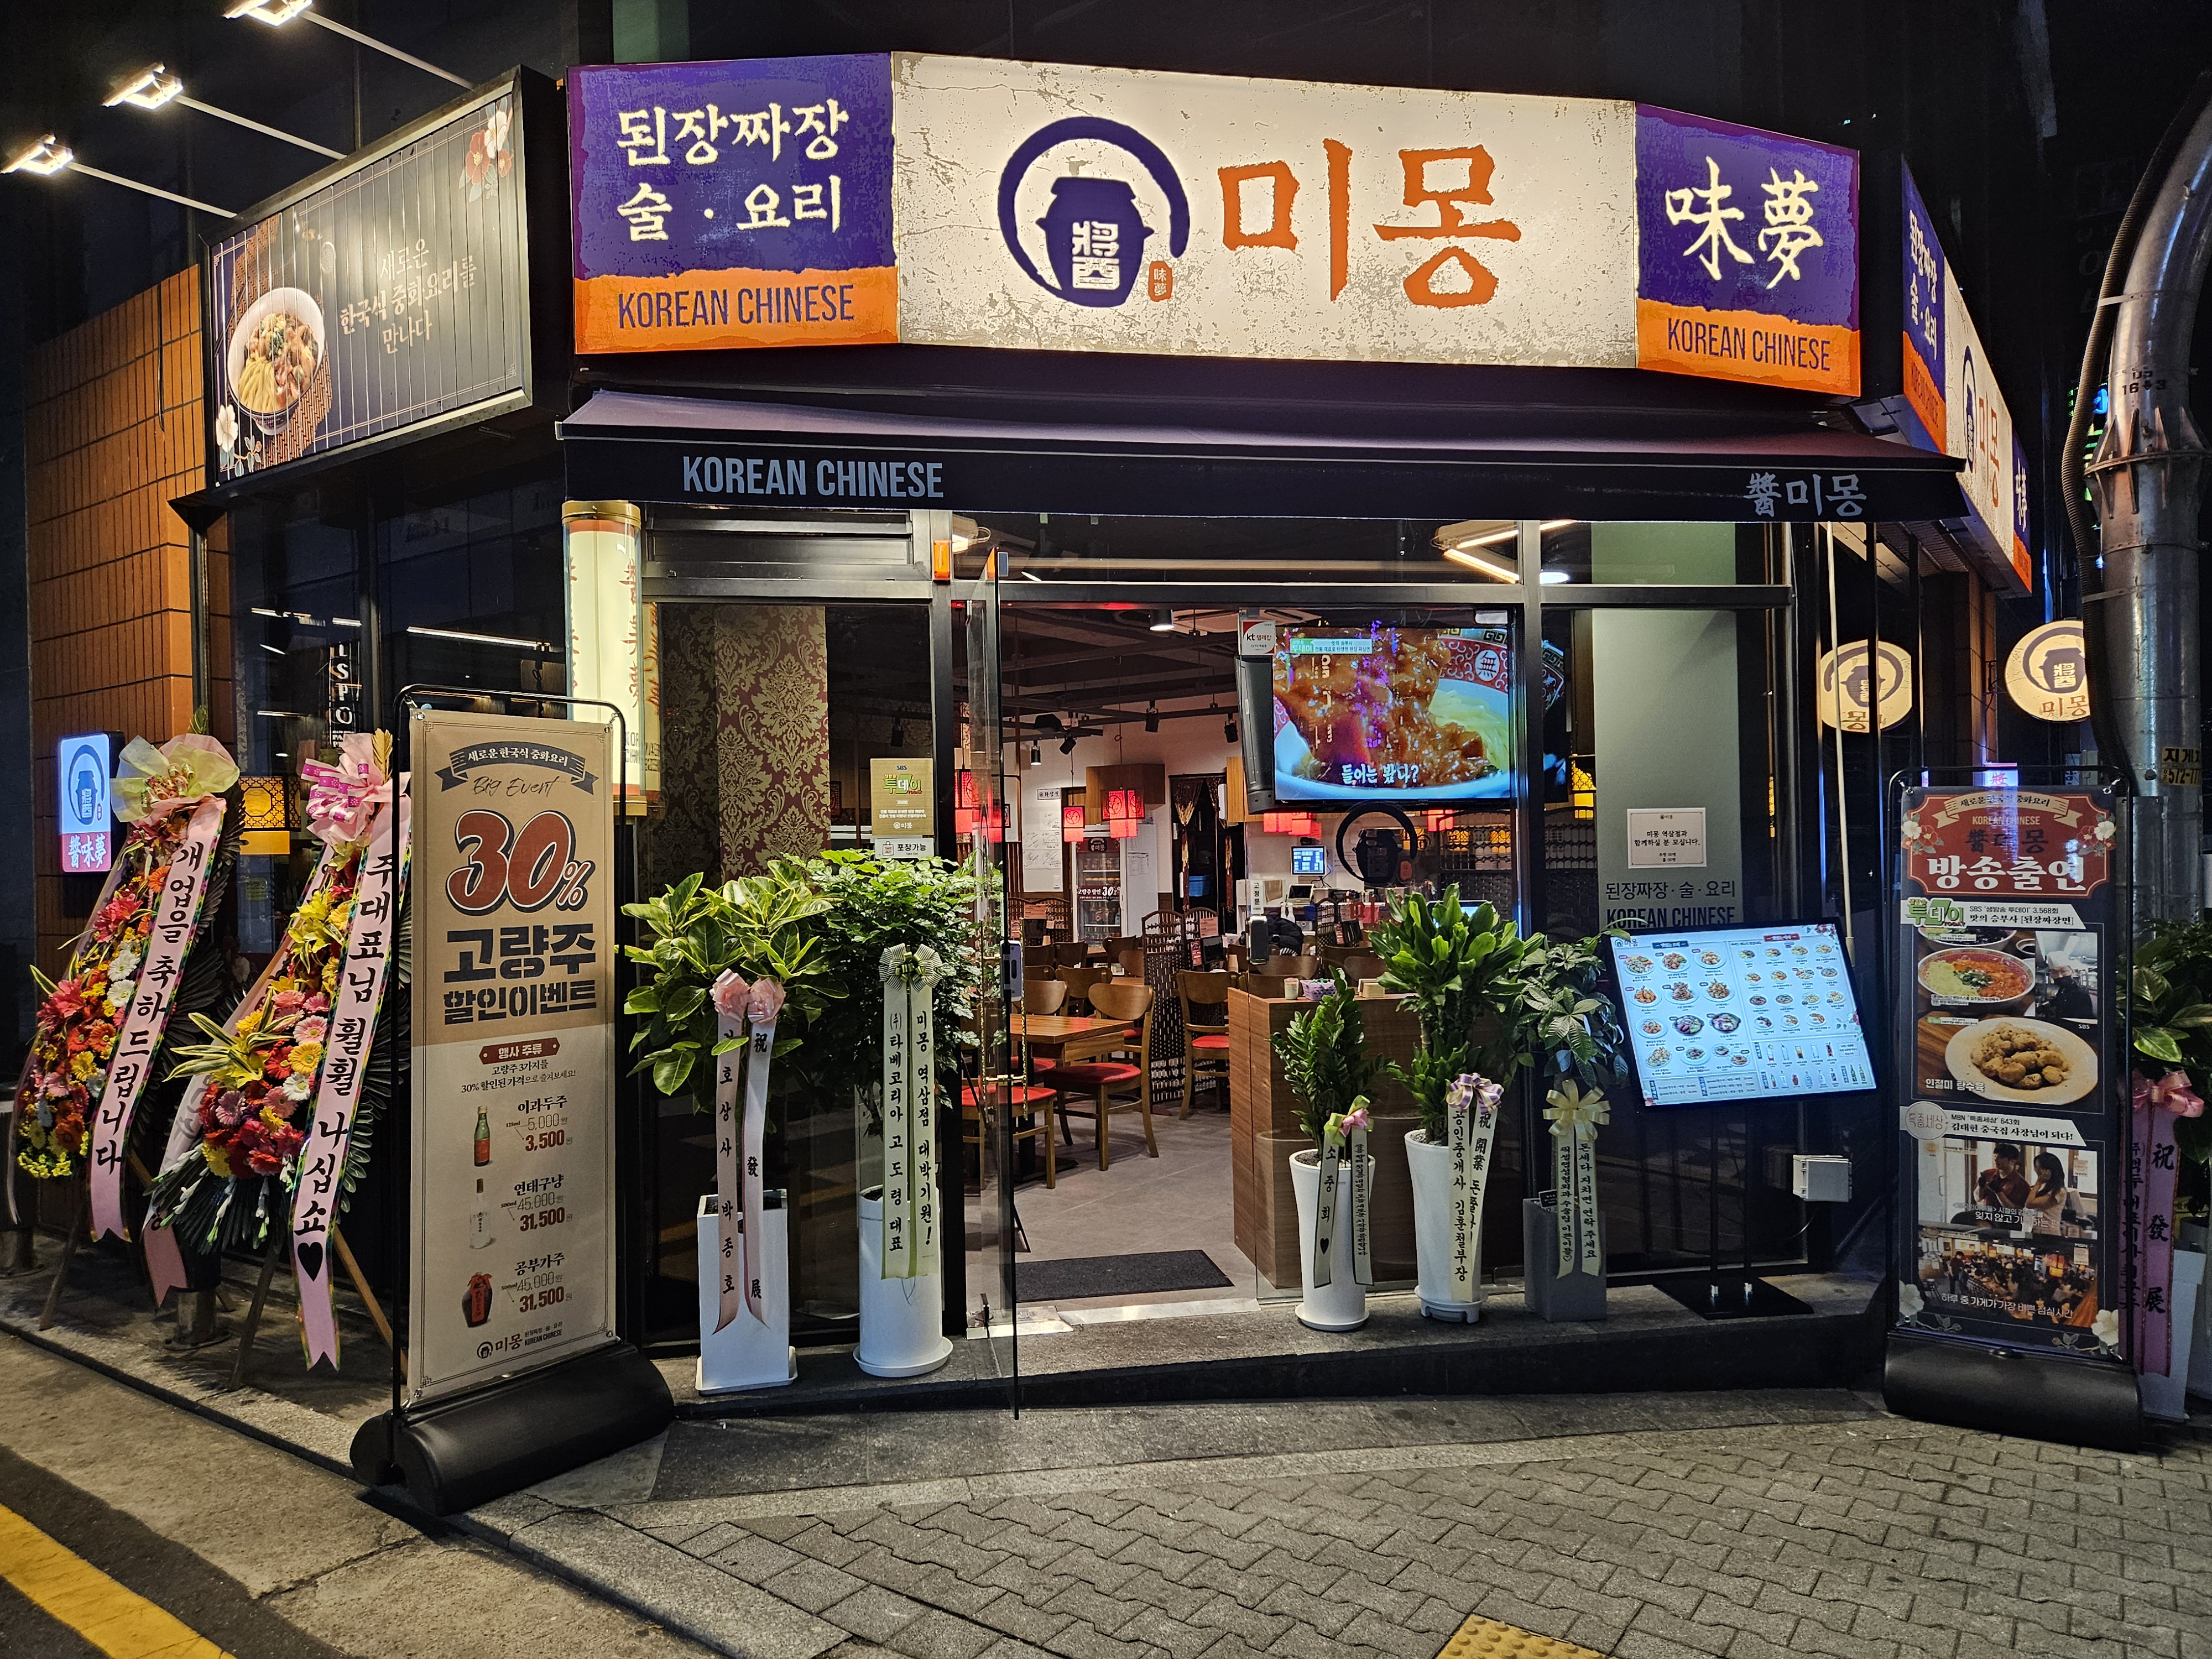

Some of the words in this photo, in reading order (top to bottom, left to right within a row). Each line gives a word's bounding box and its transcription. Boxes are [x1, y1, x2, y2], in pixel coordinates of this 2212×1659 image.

[617, 98, 849, 166] 된장짜장
[617, 182, 672, 241] 술
[736, 175, 841, 233] 요리
[1217, 138, 1522, 308] 미몽
[1665, 156, 1824, 290] 味夢
[379, 238, 430, 279] 새로운
[340, 291, 388, 335] 한국식
[391, 255, 477, 315] 중화요리를
[618, 288, 728, 328] KOREAN
[737, 284, 855, 324] CHINESE
[382, 311, 432, 354] 만나다
[1668, 318, 1747, 361] KOREAN
[1752, 330, 1830, 372] CHINESE
[684, 456, 806, 495] KOREAN
[816, 460, 944, 498] CHINESE
[2042, 695, 2088, 717] 미몽
[467, 749, 498, 762] 새로운
[499, 747, 529, 759] 한국식
[530, 750, 568, 767] 중화요리
[473, 776, 502, 797] Big
[505, 775, 566, 797] Event
[883, 779, 921, 794] 투데이
[1341, 764, 1378, 784] 들어는
[1960, 796, 1986, 807] 새로운
[445, 809, 596, 916] 30%
[1927, 855, 2086, 890] 방송출연
[158, 842, 205, 943] 개업을
[1605, 881, 1668, 900] 된장짜장
[1679, 881, 1694, 898] 술
[1705, 880, 1735, 897] 요리
[1607, 908, 1667, 928] KOREAN
[1672, 906, 1735, 927] CHINESE
[1907, 901, 1964, 926] 투데이
[1970, 914, 1987, 923] 맛의
[1990, 915, 2018, 924] 승부사
[347, 853, 394, 1005] 주대표님
[444, 923, 596, 983] 고량주
[444, 979, 596, 1025] 할인이벤트
[916, 1011, 929, 1053] 미몽
[95, 955, 176, 1176] 축하드립니다
[326, 1016, 366, 1096] 훨훨
[498, 1045, 519, 1060] 행사
[521, 1042, 542, 1057] 주류
[491, 1063, 518, 1076] 고량주
[519, 1060, 549, 1072] 3가지를
[461, 1083, 479, 1093] 30%
[480, 1078, 507, 1091] 할인된
[507, 1074, 539, 1088] 가격으로
[917, 1065, 930, 1127] 역삼점
[1926, 1079, 1953, 1089] 인절미
[1956, 1080, 1985, 1093] 탕수육
[518, 1095, 568, 1113] 이과두주
[1909, 1112, 1943, 1130] 특종세상
[1980, 1126, 2008, 1135] 중국집
[2011, 1128, 2048, 1139] 사장님이
[2051, 1132, 2073, 1140] 되다!
[1452, 1110, 1467, 1191] 공인중개사
[1578, 1143, 1593, 1172] 돈세다
[294, 1112, 349, 1237] 나십쇼
[514, 1174, 565, 1197] 연태구냥
[917, 1139, 933, 1245] 대박기원!
[1583, 1208, 1596, 1227] 연락
[1975, 1211, 1992, 1222] 잊지
[1995, 1213, 2012, 1224] 않고
[721, 1200, 735, 1294] 박종호
[889, 1217, 904, 1251] 대표
[1583, 1230, 1597, 1258] 주세요
[514, 1252, 565, 1276] 공부가주
[1942, 1293, 1958, 1303] 하루
[1960, 1295, 1969, 1305] 중
[1971, 1296, 1997, 1308] 가게가
[1999, 1300, 2016, 1311] 가장
[495, 1333, 523, 1353] 미몽
[524, 1333, 542, 1347] KOREAN
[542, 1329, 562, 1342] CHINESE
